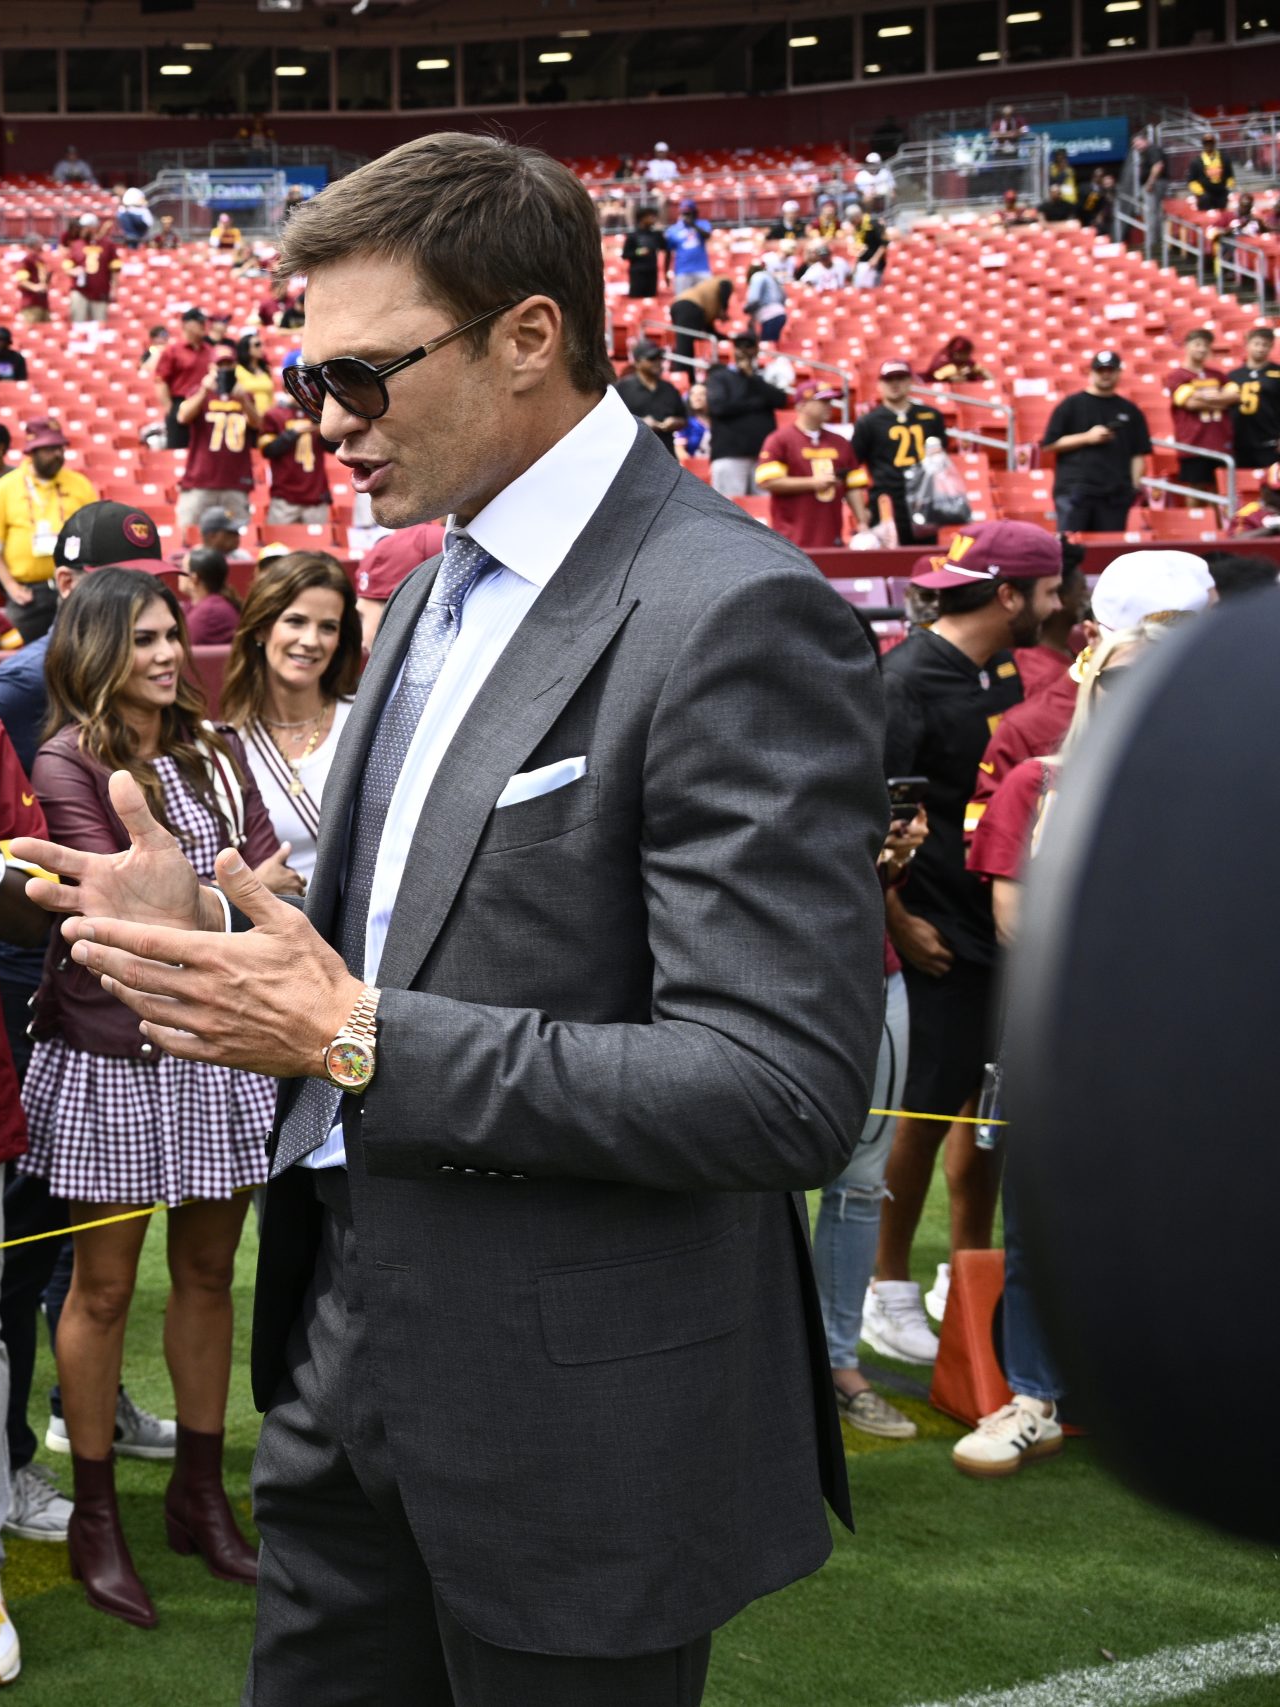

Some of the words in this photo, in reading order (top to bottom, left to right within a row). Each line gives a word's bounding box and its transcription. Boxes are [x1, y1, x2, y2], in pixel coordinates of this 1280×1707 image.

[1240, 381, 1261, 415] 5
[205, 412, 247, 452] 70
[889, 424, 926, 467] 21
